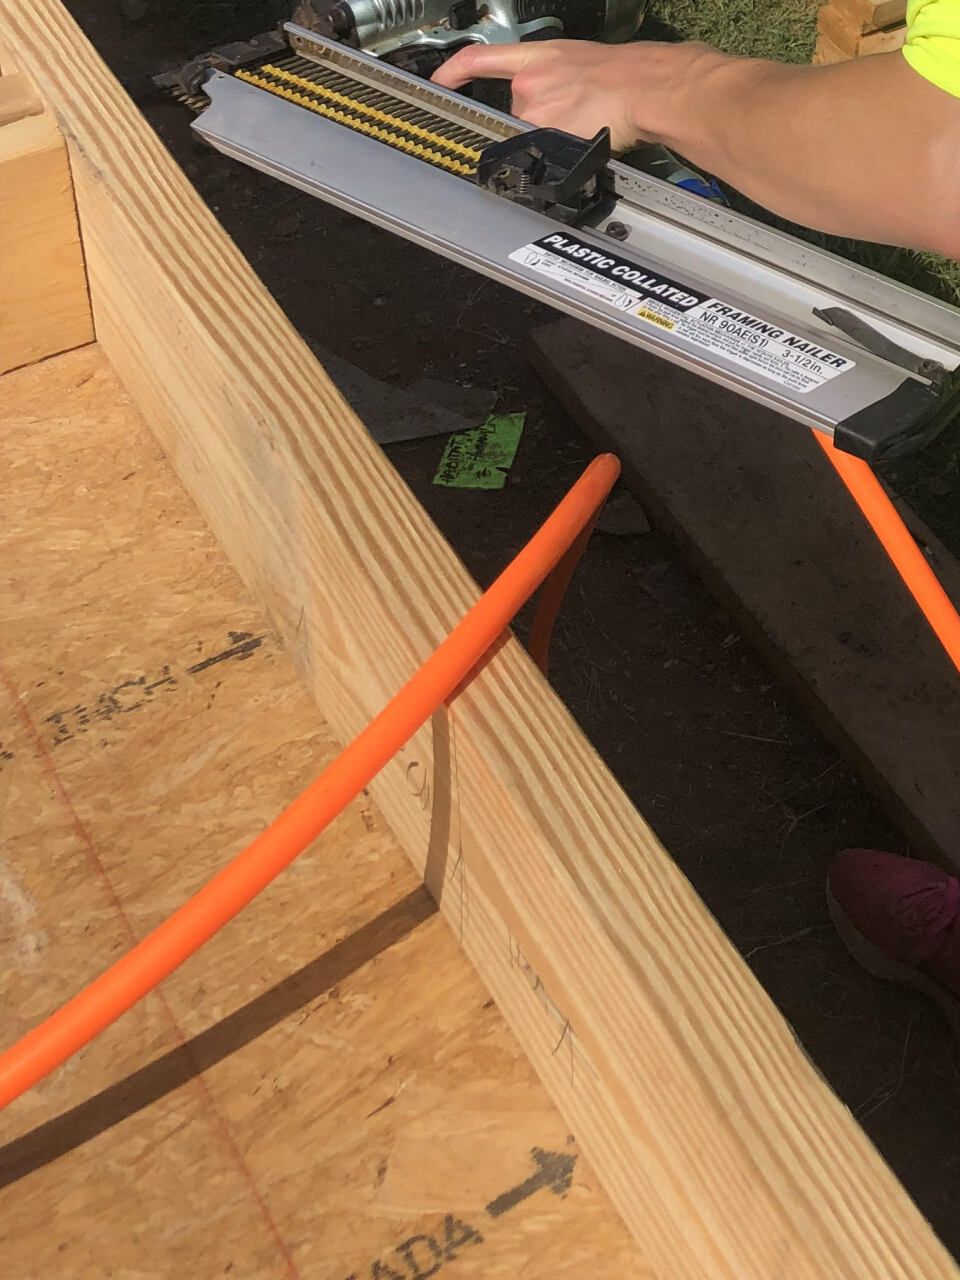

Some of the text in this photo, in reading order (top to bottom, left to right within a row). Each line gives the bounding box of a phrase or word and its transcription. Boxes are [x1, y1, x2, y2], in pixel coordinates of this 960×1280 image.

[543, 234, 616, 269] PLASTIC
[611, 264, 699, 308] COLLATED
[707, 302, 785, 339] FRAMING
[782, 337, 847, 369] NAILER
[700, 311, 718, 325] NR
